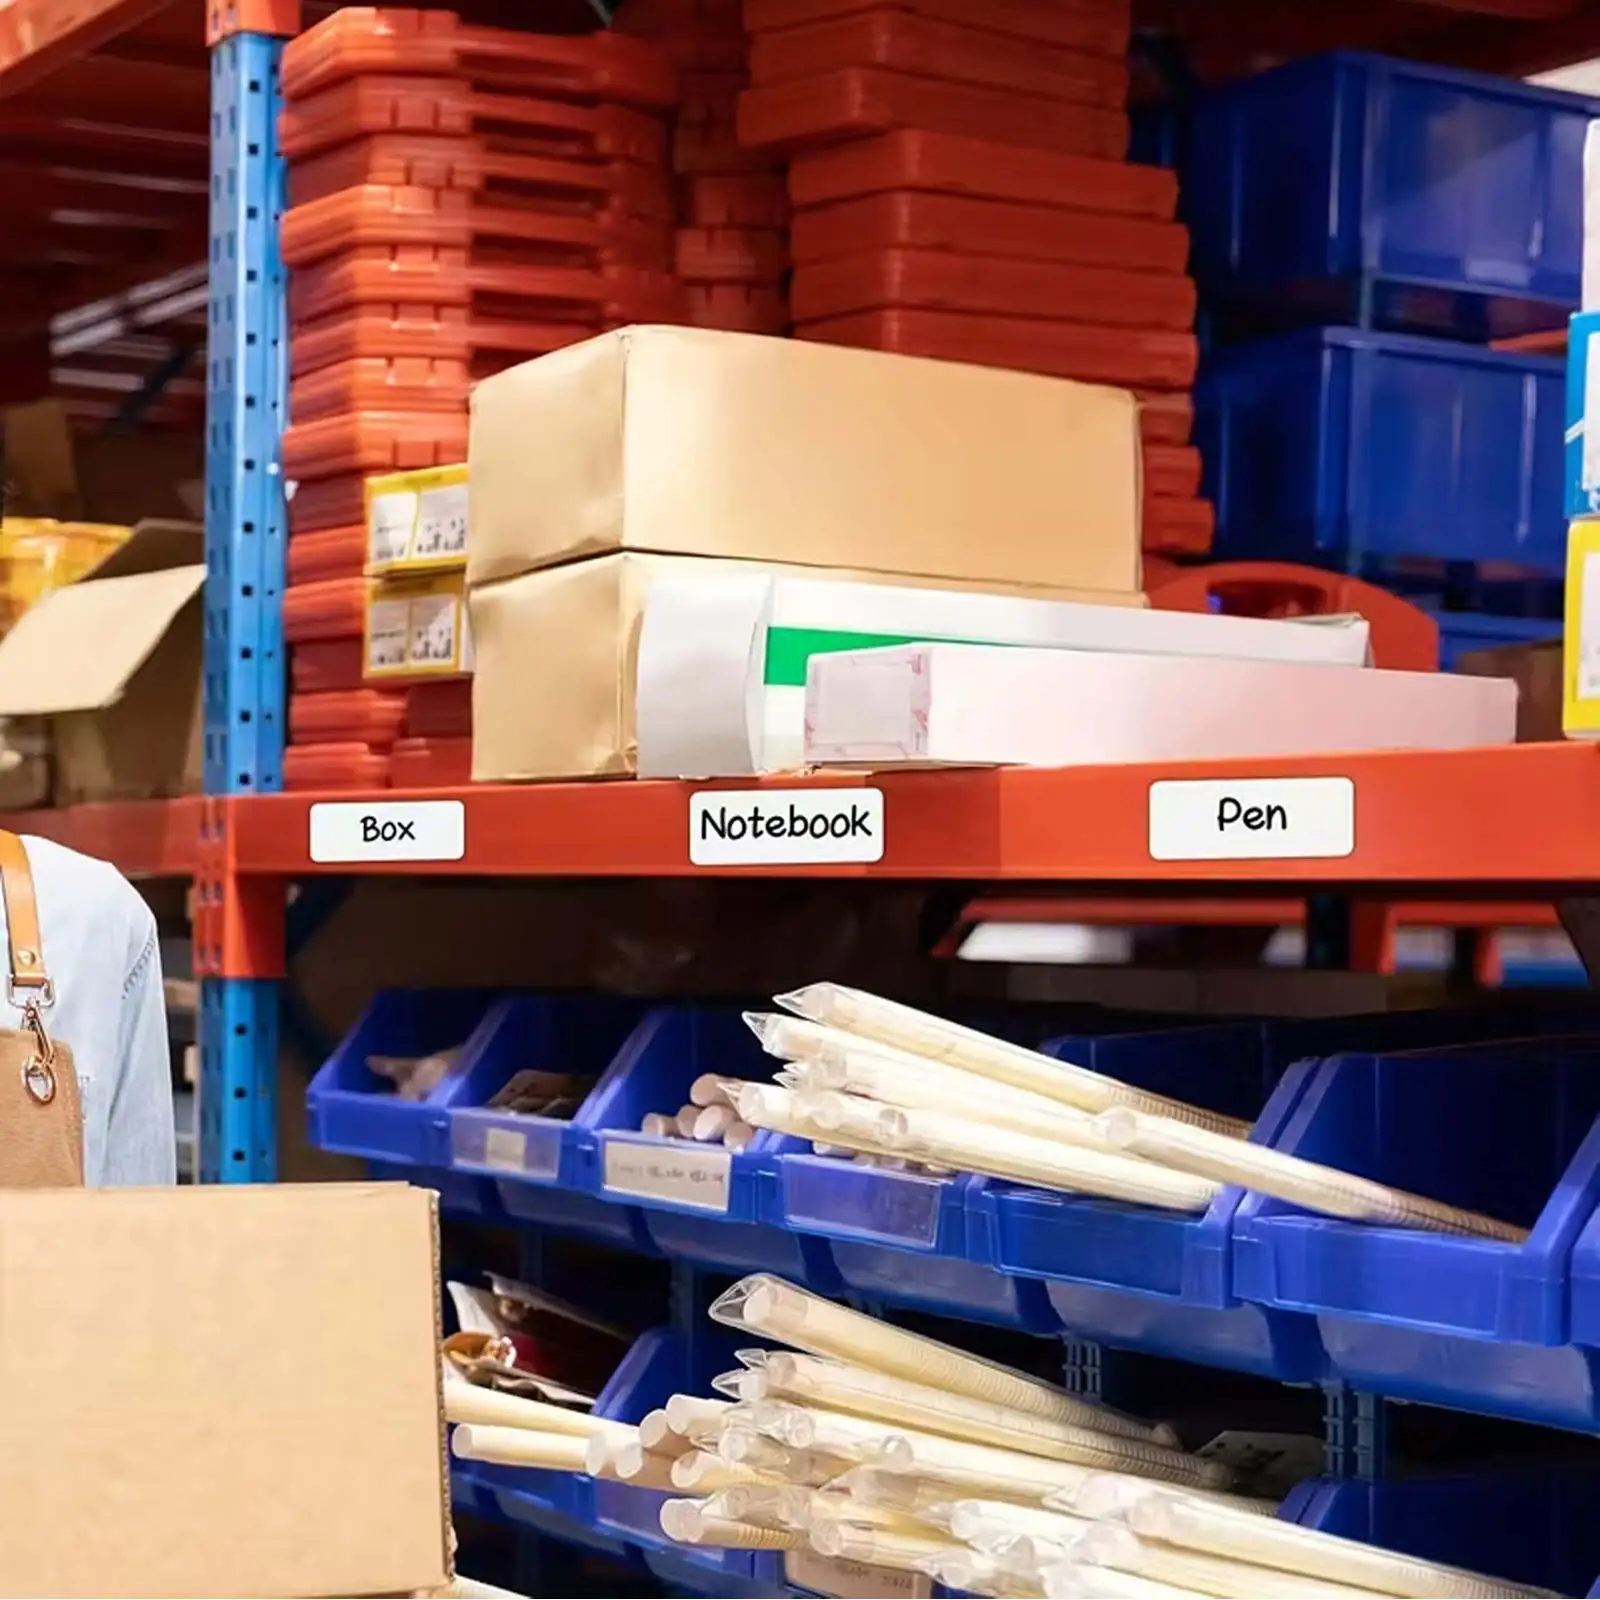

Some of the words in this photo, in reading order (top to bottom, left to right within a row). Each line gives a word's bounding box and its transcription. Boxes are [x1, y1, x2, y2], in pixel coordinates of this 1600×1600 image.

[361, 815, 416, 843] Box
[701, 804, 872, 841] Notebook
[1217, 797, 1287, 832] Pen
